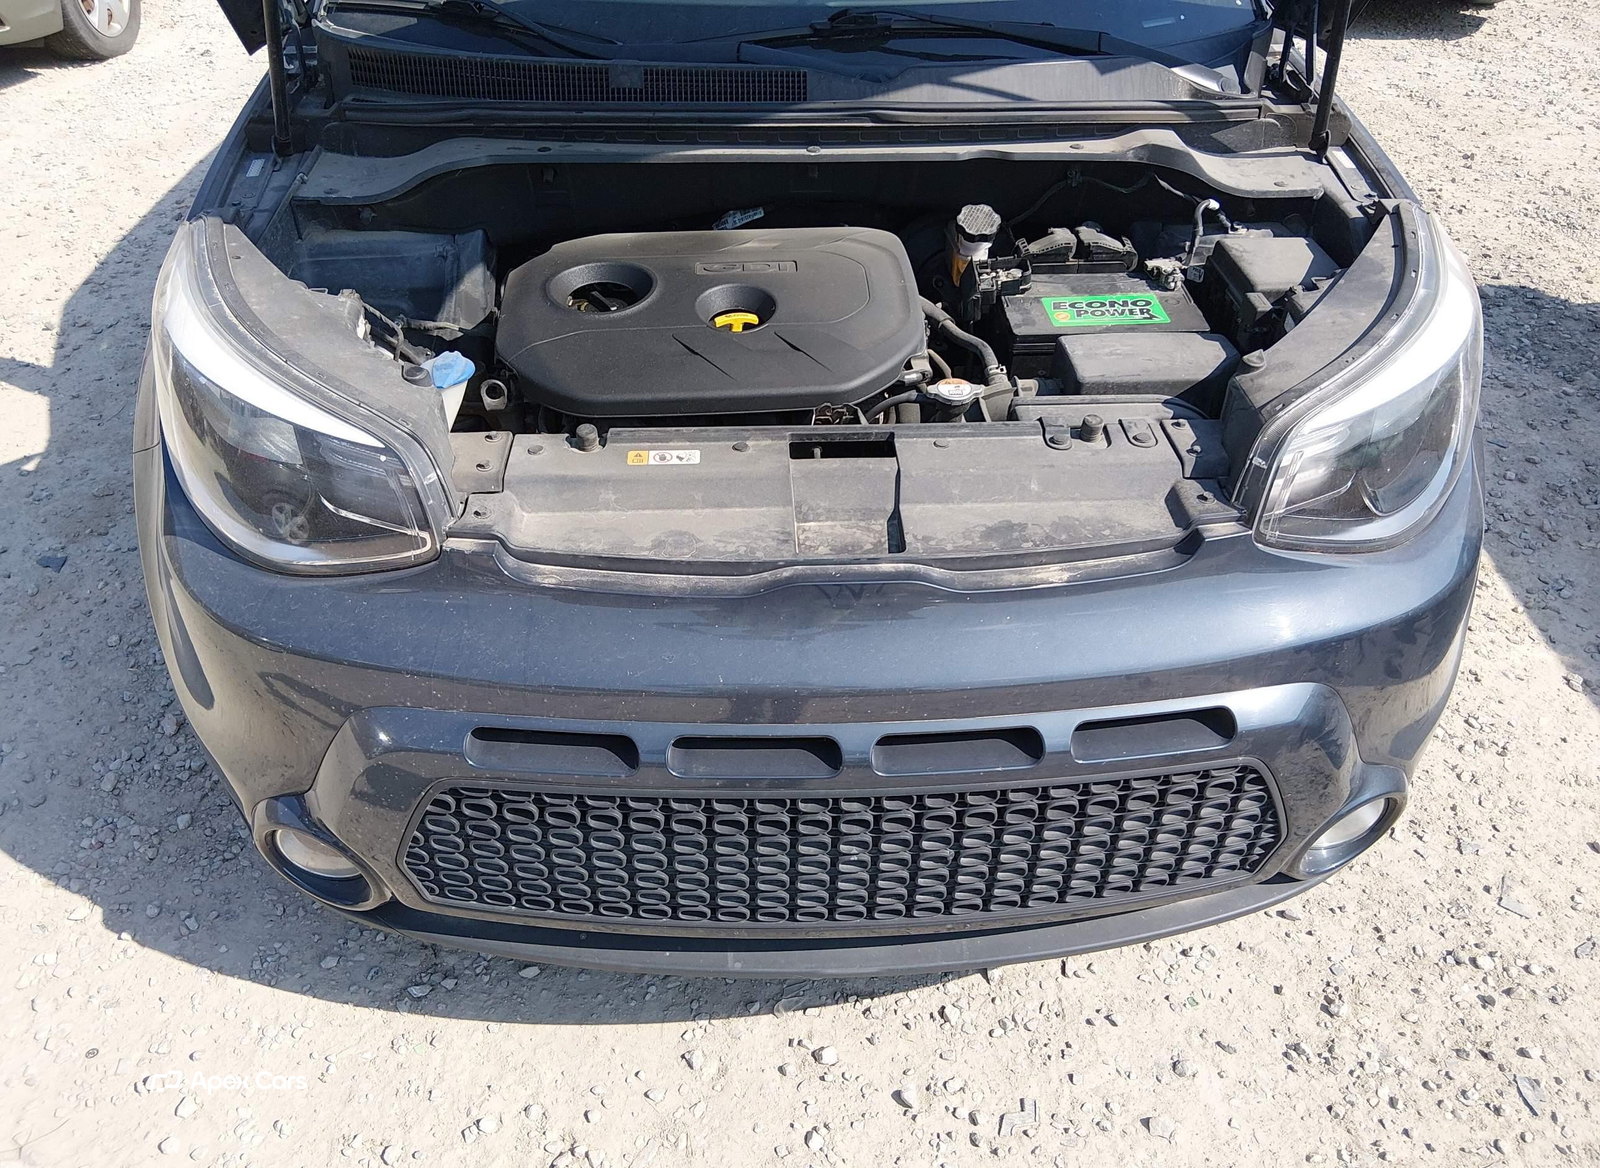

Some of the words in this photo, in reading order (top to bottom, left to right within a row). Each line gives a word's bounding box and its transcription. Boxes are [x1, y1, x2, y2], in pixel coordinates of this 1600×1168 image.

[702, 262, 789, 273] GDI
[1052, 299, 1153, 310] ECONO
[1075, 308, 1160, 320] POWER
